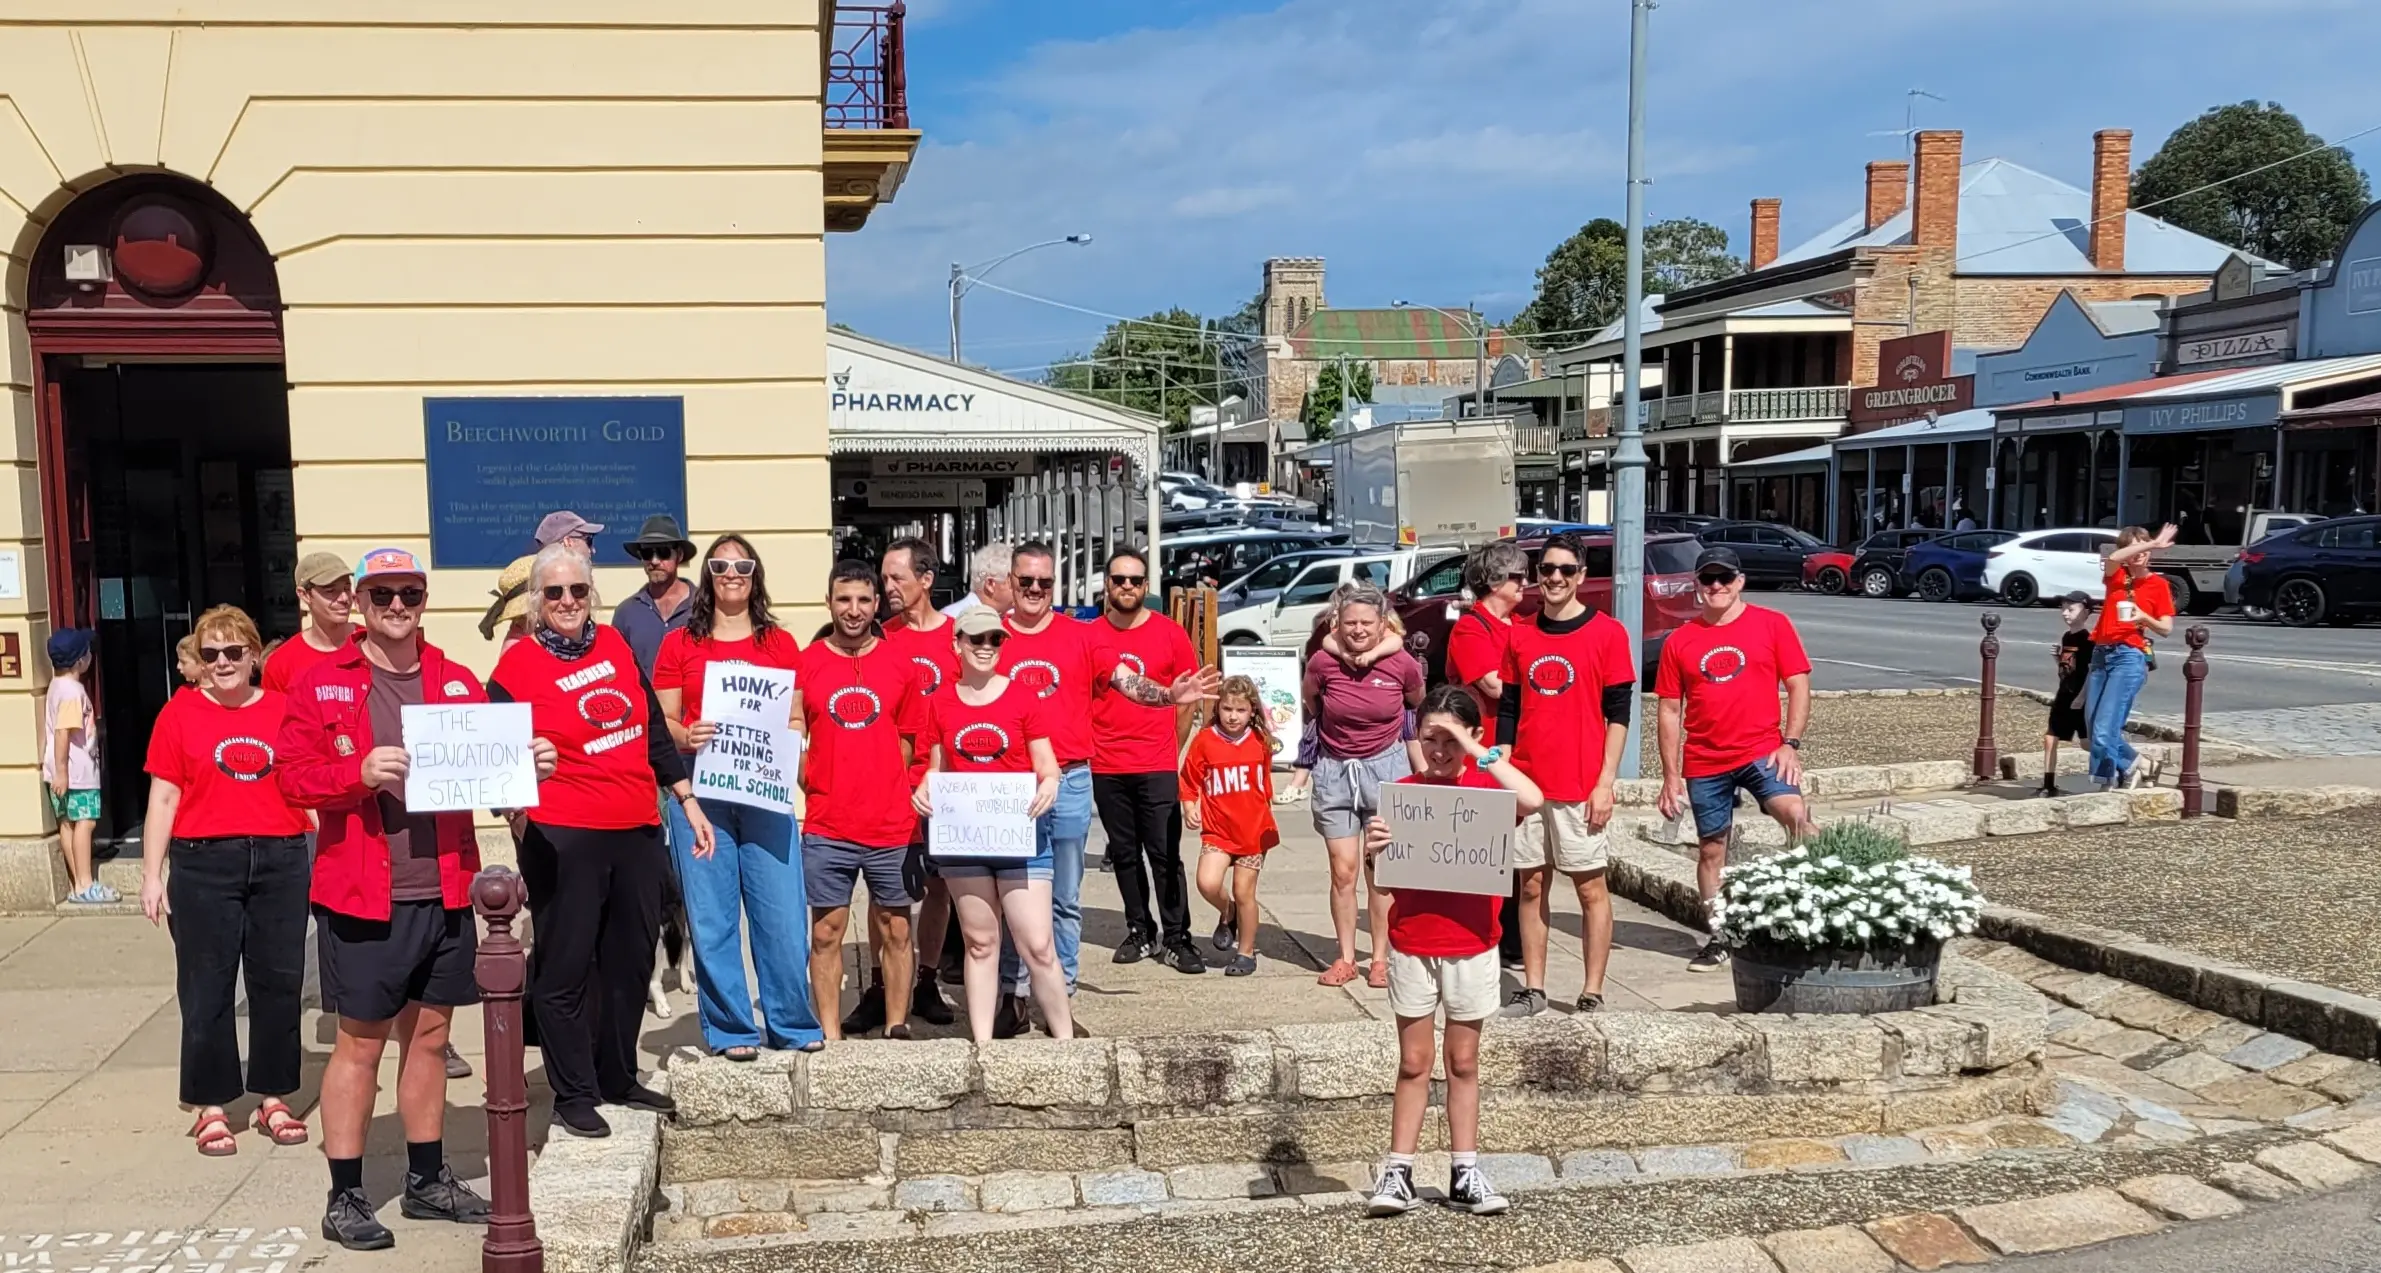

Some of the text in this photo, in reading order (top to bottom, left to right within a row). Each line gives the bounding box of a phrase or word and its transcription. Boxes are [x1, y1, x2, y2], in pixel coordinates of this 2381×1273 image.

[2190, 335, 2275, 360] PIZZA
[832, 393, 976, 412] PHARMACY
[1865, 384, 1957, 409] GREENGROCER
[2149, 402, 2248, 427] IVY PHILLIPS
[446, 419, 665, 443] BEECHWORTH GOLD
[906, 461, 1020, 473] PHARMACY
[920, 489, 945, 500] BANK
[963, 489, 984, 499] ATM
[555, 660, 616, 693] TEACHERS
[721, 675, 790, 702] HONK!
[739, 698, 762, 713] FOR
[828, 686, 855, 714] AUSTRALIAN
[426, 708, 478, 733] THE
[582, 724, 643, 756] PRINCIPALS
[714, 722, 772, 747] BETTER
[954, 722, 982, 750] AUSTRALIAN
[415, 742, 519, 769] EDUCATION
[710, 738, 774, 764] FUNDING
[733, 758, 783, 782] FOR YOUR
[427, 771, 514, 807] STATE?
[698, 769, 793, 806] LOCAL SCHOOL
[936, 776, 978, 796] WEAR
[975, 798, 1030, 816] PUBLIC
[1392, 792, 1480, 834] Honk for
[1386, 832, 1508, 876] our school!
[98, 1242, 301, 1264] GIVE
